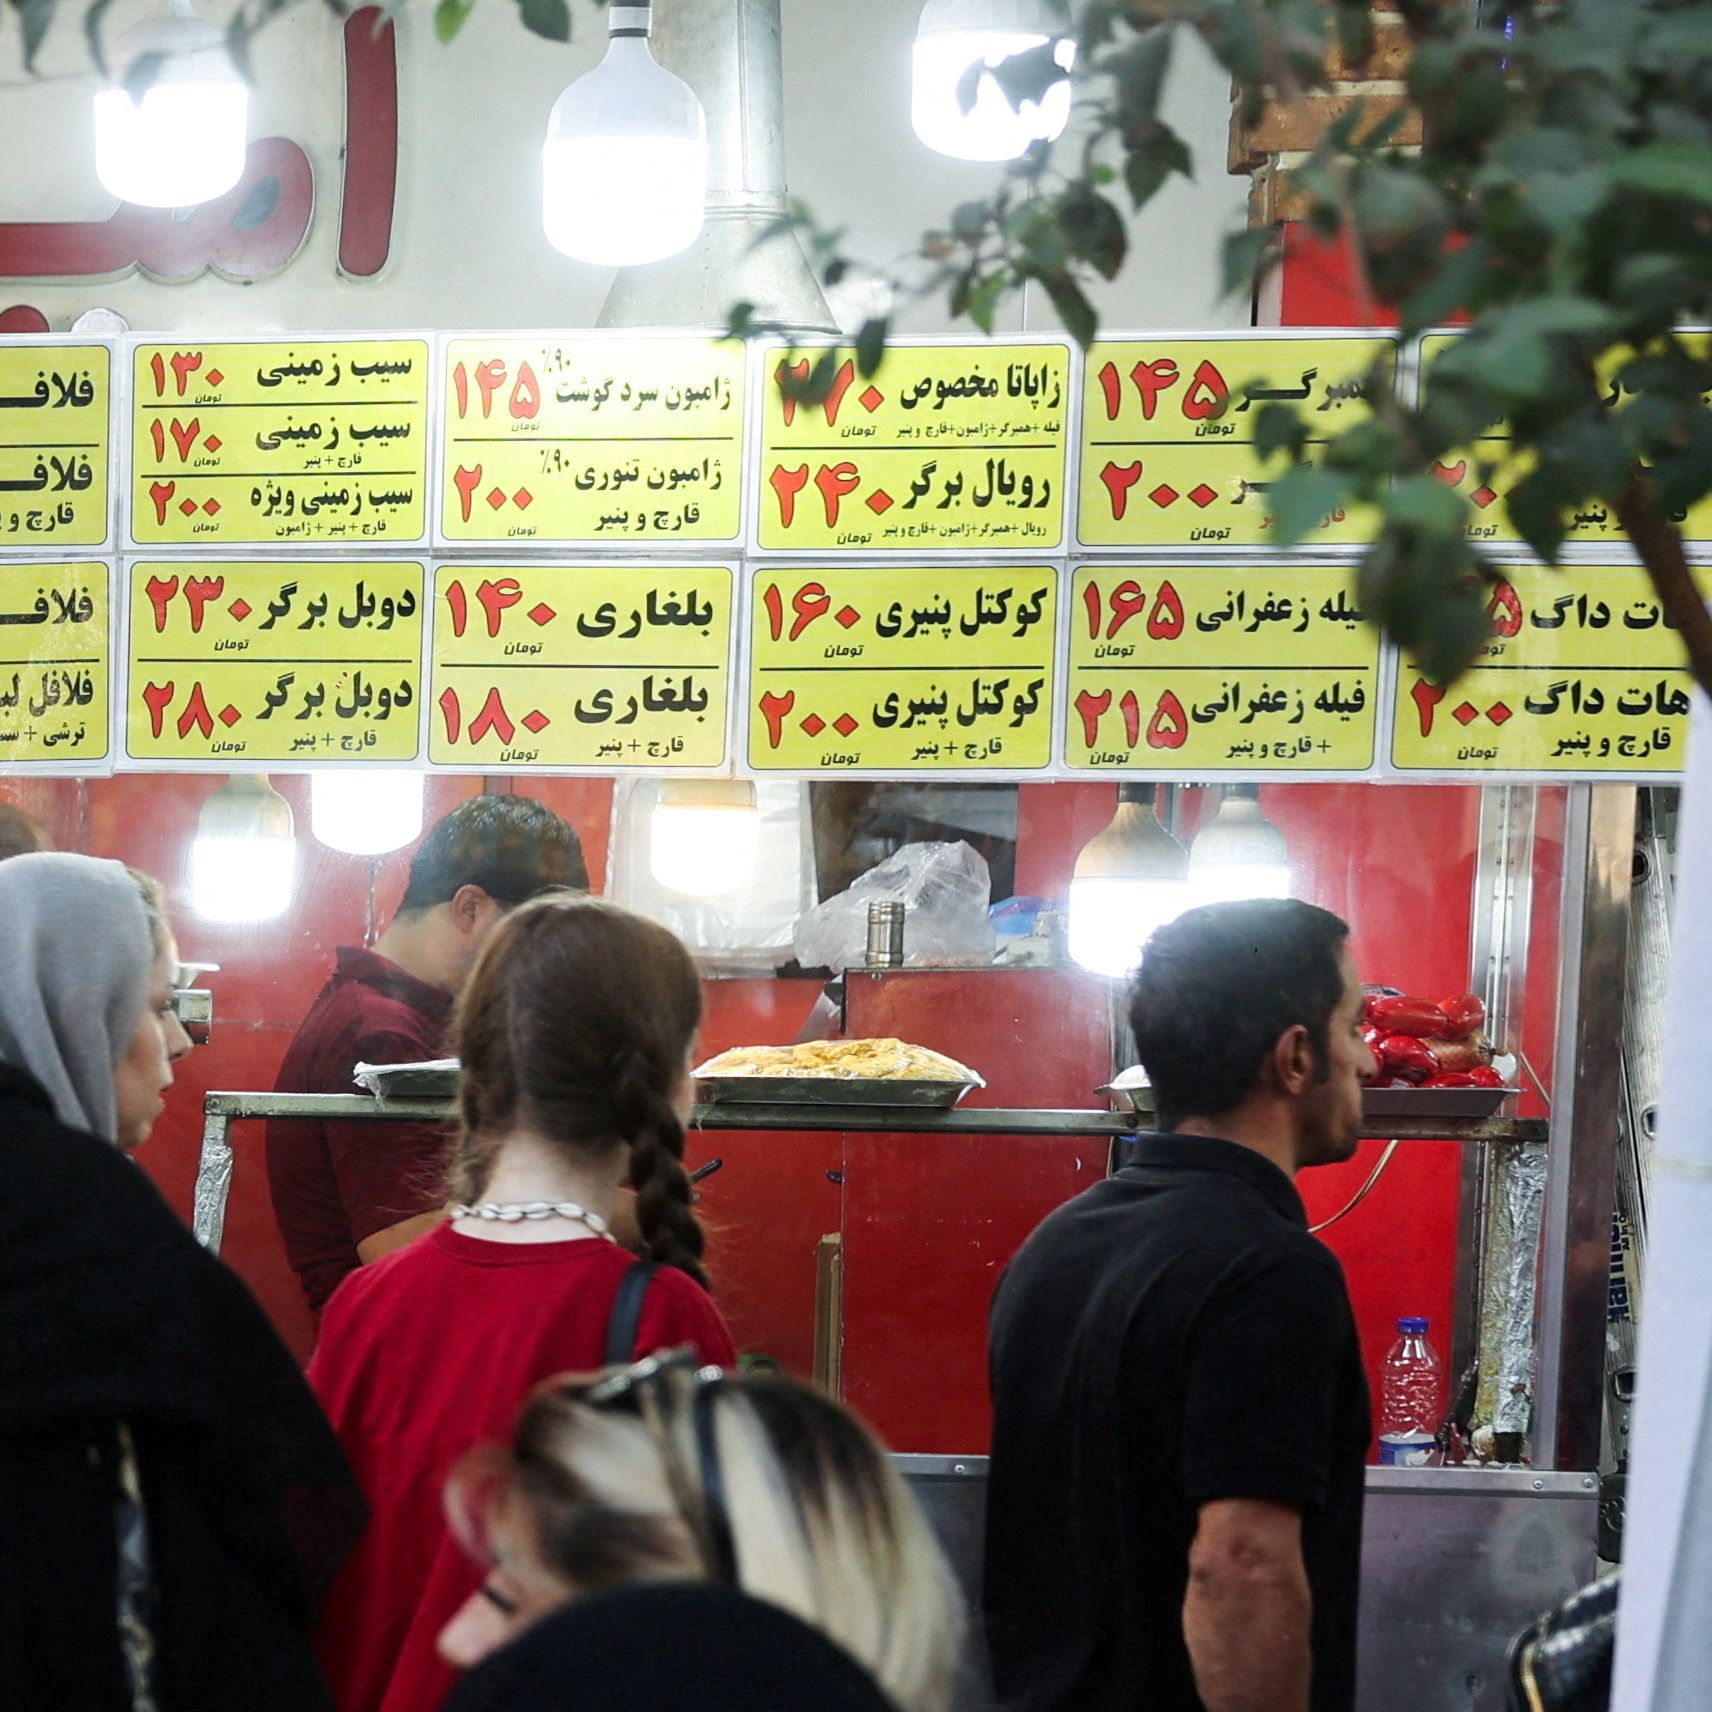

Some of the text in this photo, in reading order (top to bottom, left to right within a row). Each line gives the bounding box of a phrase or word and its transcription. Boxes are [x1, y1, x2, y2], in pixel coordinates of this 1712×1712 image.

[1098, 358, 1369, 421] مبرگر ۱۴۵
[26, 502, 74, 532] قارچ
[149, 479, 413, 526] سیب زمینی ویژه ۲۰۰
[769, 458, 1050, 528] رویال برگر ۲۴۰
[1100, 460, 1218, 521] ۲۰۰
[145, 575, 416, 633] دوبل برگر ۲۳۰
[445, 578, 713, 639] بلغاری ۱۴۰
[764, 582, 1048, 641] کوکتل پنیری ۱۶۰
[1530, 593, 1611, 629] داگ
[504, 642, 543, 655] تومان
[29, 669, 94, 717] فلافل
[142, 671, 413, 739] دوبل برگر ۲۸۰
[439, 675, 708, 745] بلغاری ۱۸۰
[758, 678, 1044, 749] کوکتل پنیری ۲۰۰
[1074, 679, 1365, 749] فیله زعفرانی ۲۱۵
[1411, 678, 1690, 737] هات داگ ۲۰۰
[289, 733, 316, 753] پنیر
[340, 729, 377, 752] قارچ
[595, 738, 623, 758] پنیر
[647, 736, 684, 758] قارچ
[911, 741, 939, 761] پنیر
[965, 737, 1002, 760] قارچ
